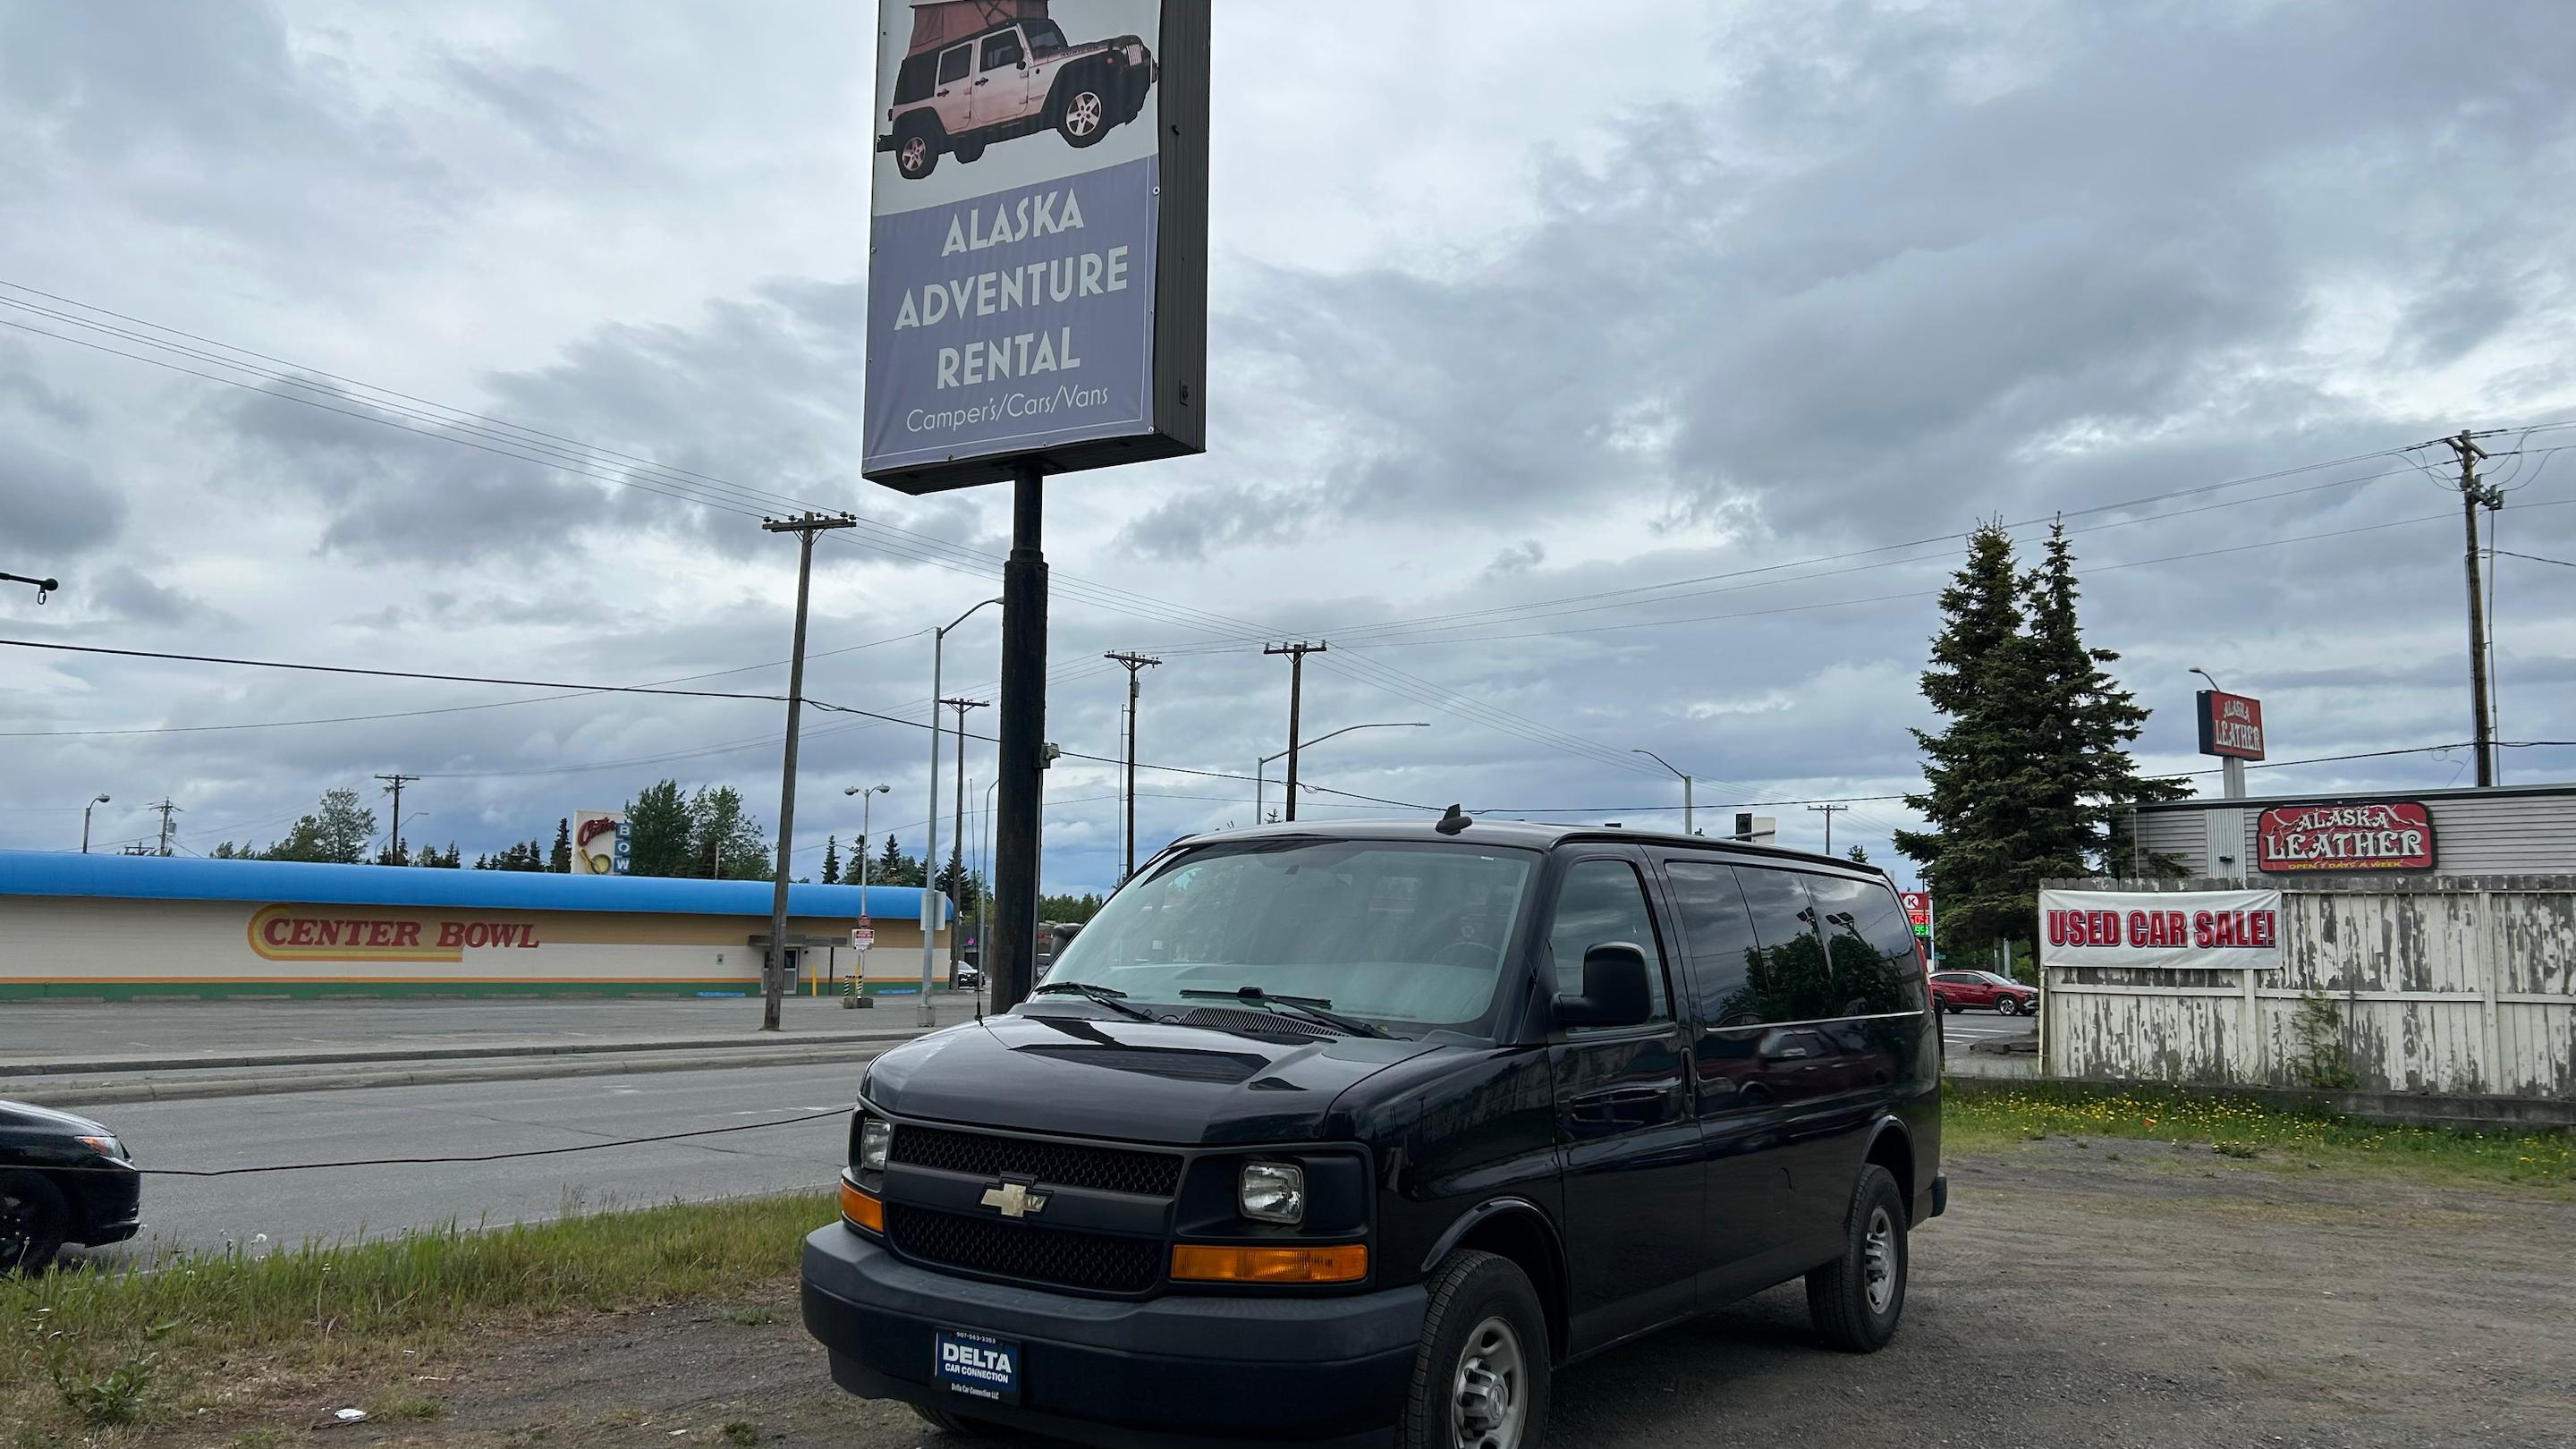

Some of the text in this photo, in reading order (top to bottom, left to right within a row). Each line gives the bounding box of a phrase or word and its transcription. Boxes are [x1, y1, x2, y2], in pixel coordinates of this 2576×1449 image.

[941, 187, 1085, 258] ALASKA
[894, 245, 1129, 331] ADVENTURE
[936, 326, 1081, 390] RENTAL
[2224, 700, 2250, 723] ALASKA
[2216, 720, 2261, 750] LEATHER
[2296, 809, 2390, 832] ALASKA
[2267, 830, 2425, 860] LEATHER
[1908, 898, 1918, 907] K
[264, 918, 539, 948] CENTER BOWL
[2047, 910, 2275, 948] USED CAR SALE!
[943, 1343, 1012, 1374] DELTA
[945, 1363, 1009, 1384] CAR CONNECTION
